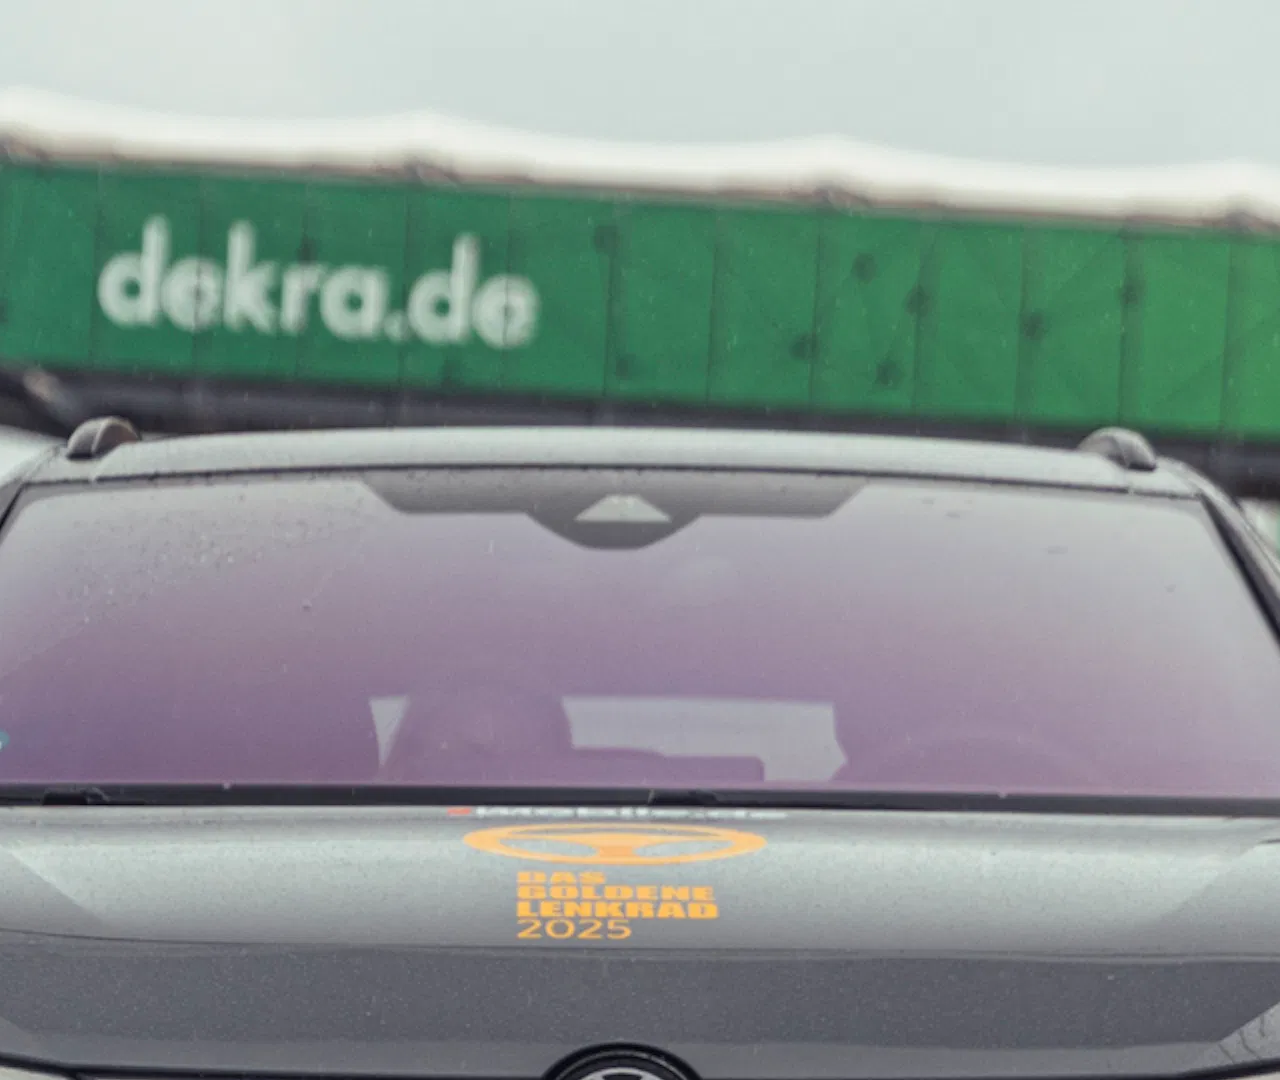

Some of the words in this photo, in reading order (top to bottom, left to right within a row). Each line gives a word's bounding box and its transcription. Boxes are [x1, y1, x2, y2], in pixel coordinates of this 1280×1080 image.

[96, 213, 542, 349] dekra.de
[516, 870, 605, 885] DAS
[516, 885, 716, 901] GOLDENE
[516, 901, 719, 919] LENKRAD
[516, 919, 632, 939] 2025
